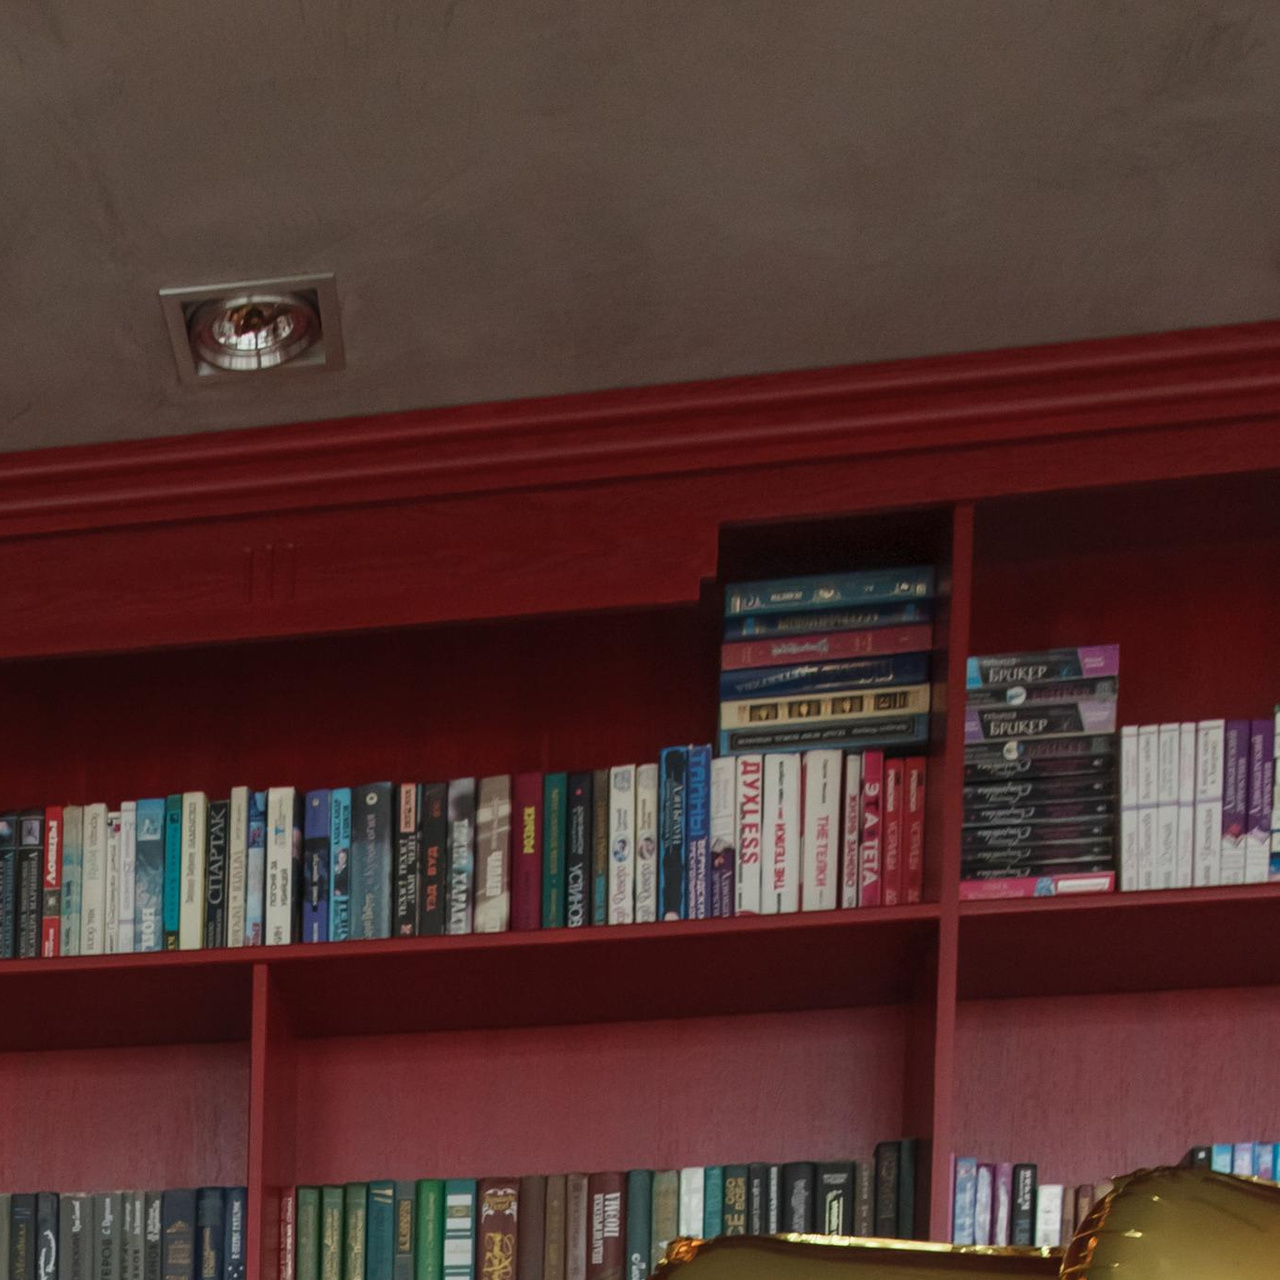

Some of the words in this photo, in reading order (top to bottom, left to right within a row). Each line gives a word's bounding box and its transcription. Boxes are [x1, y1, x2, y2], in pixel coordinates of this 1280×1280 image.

[740, 760, 761, 865] ДУХLESS
[208, 808, 226, 904] СПАРТАК
[774, 867, 785, 890] THE
[604, 1192, 620, 1237] ПОЭМА
